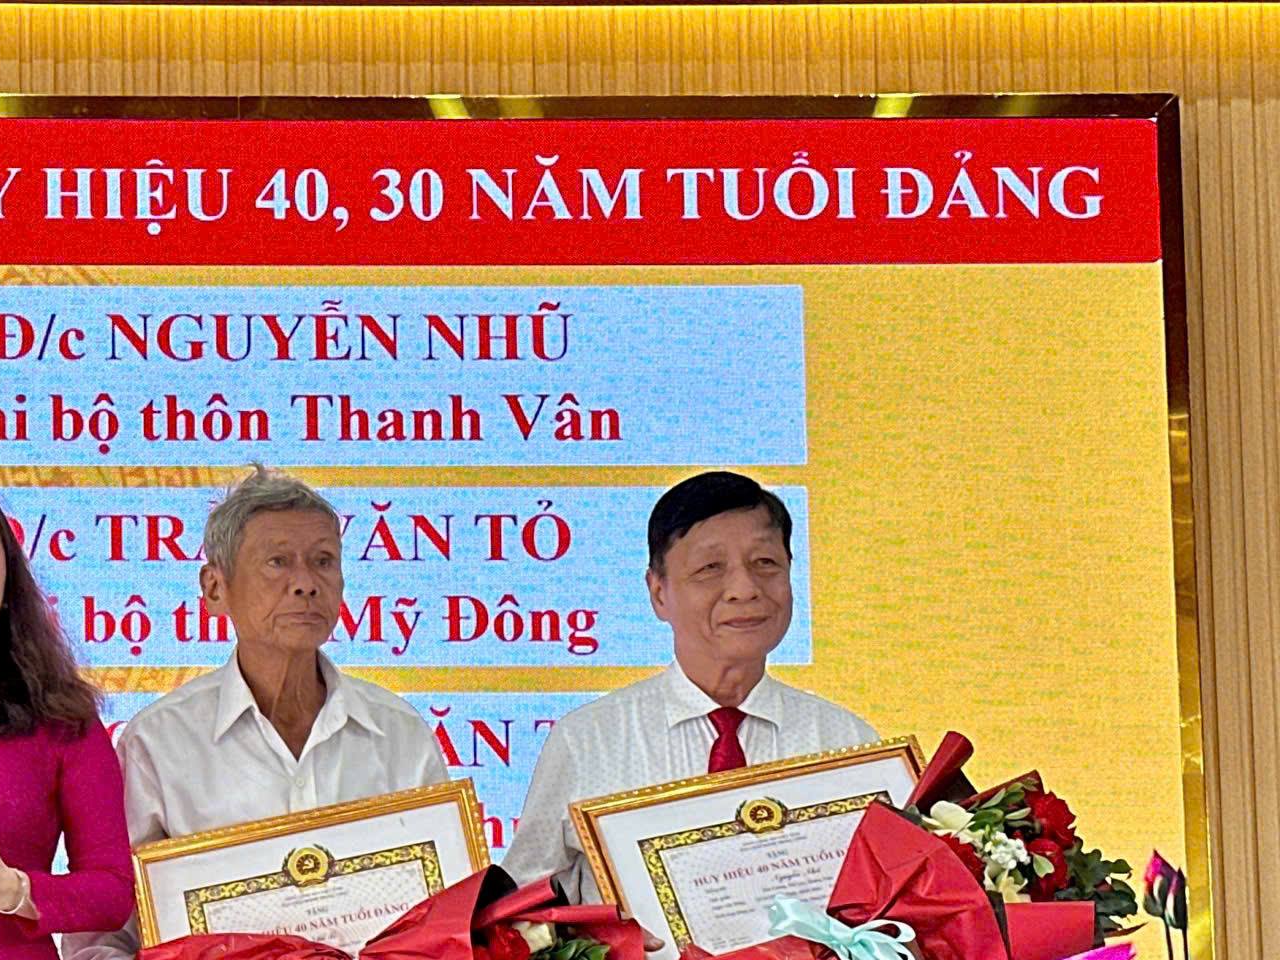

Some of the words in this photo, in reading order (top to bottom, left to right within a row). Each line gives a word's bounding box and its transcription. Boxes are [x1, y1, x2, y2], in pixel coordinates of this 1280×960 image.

[43, 159, 233, 236] HIỆU
[254, 168, 350, 233] 40,
[369, 168, 445, 223] 30
[465, 154, 653, 221] NĂM
[666, 151, 857, 221] TUỔI
[879, 151, 1104, 220] ĐẢNG
[105, 300, 401, 362] NGUYỄN
[422, 301, 574, 361] NHŨ
[49, 393, 119, 454] bộ
[140, 393, 271, 441] thôn
[291, 394, 484, 442] Thanh
[501, 393, 623, 441] Vân
[474, 500, 572, 562] TỎ
[82, 594, 151, 656] bộ
[329, 595, 424, 656] Mỹ
[442, 594, 600, 655] Đông
[693, 874, 720, 887] HUY
